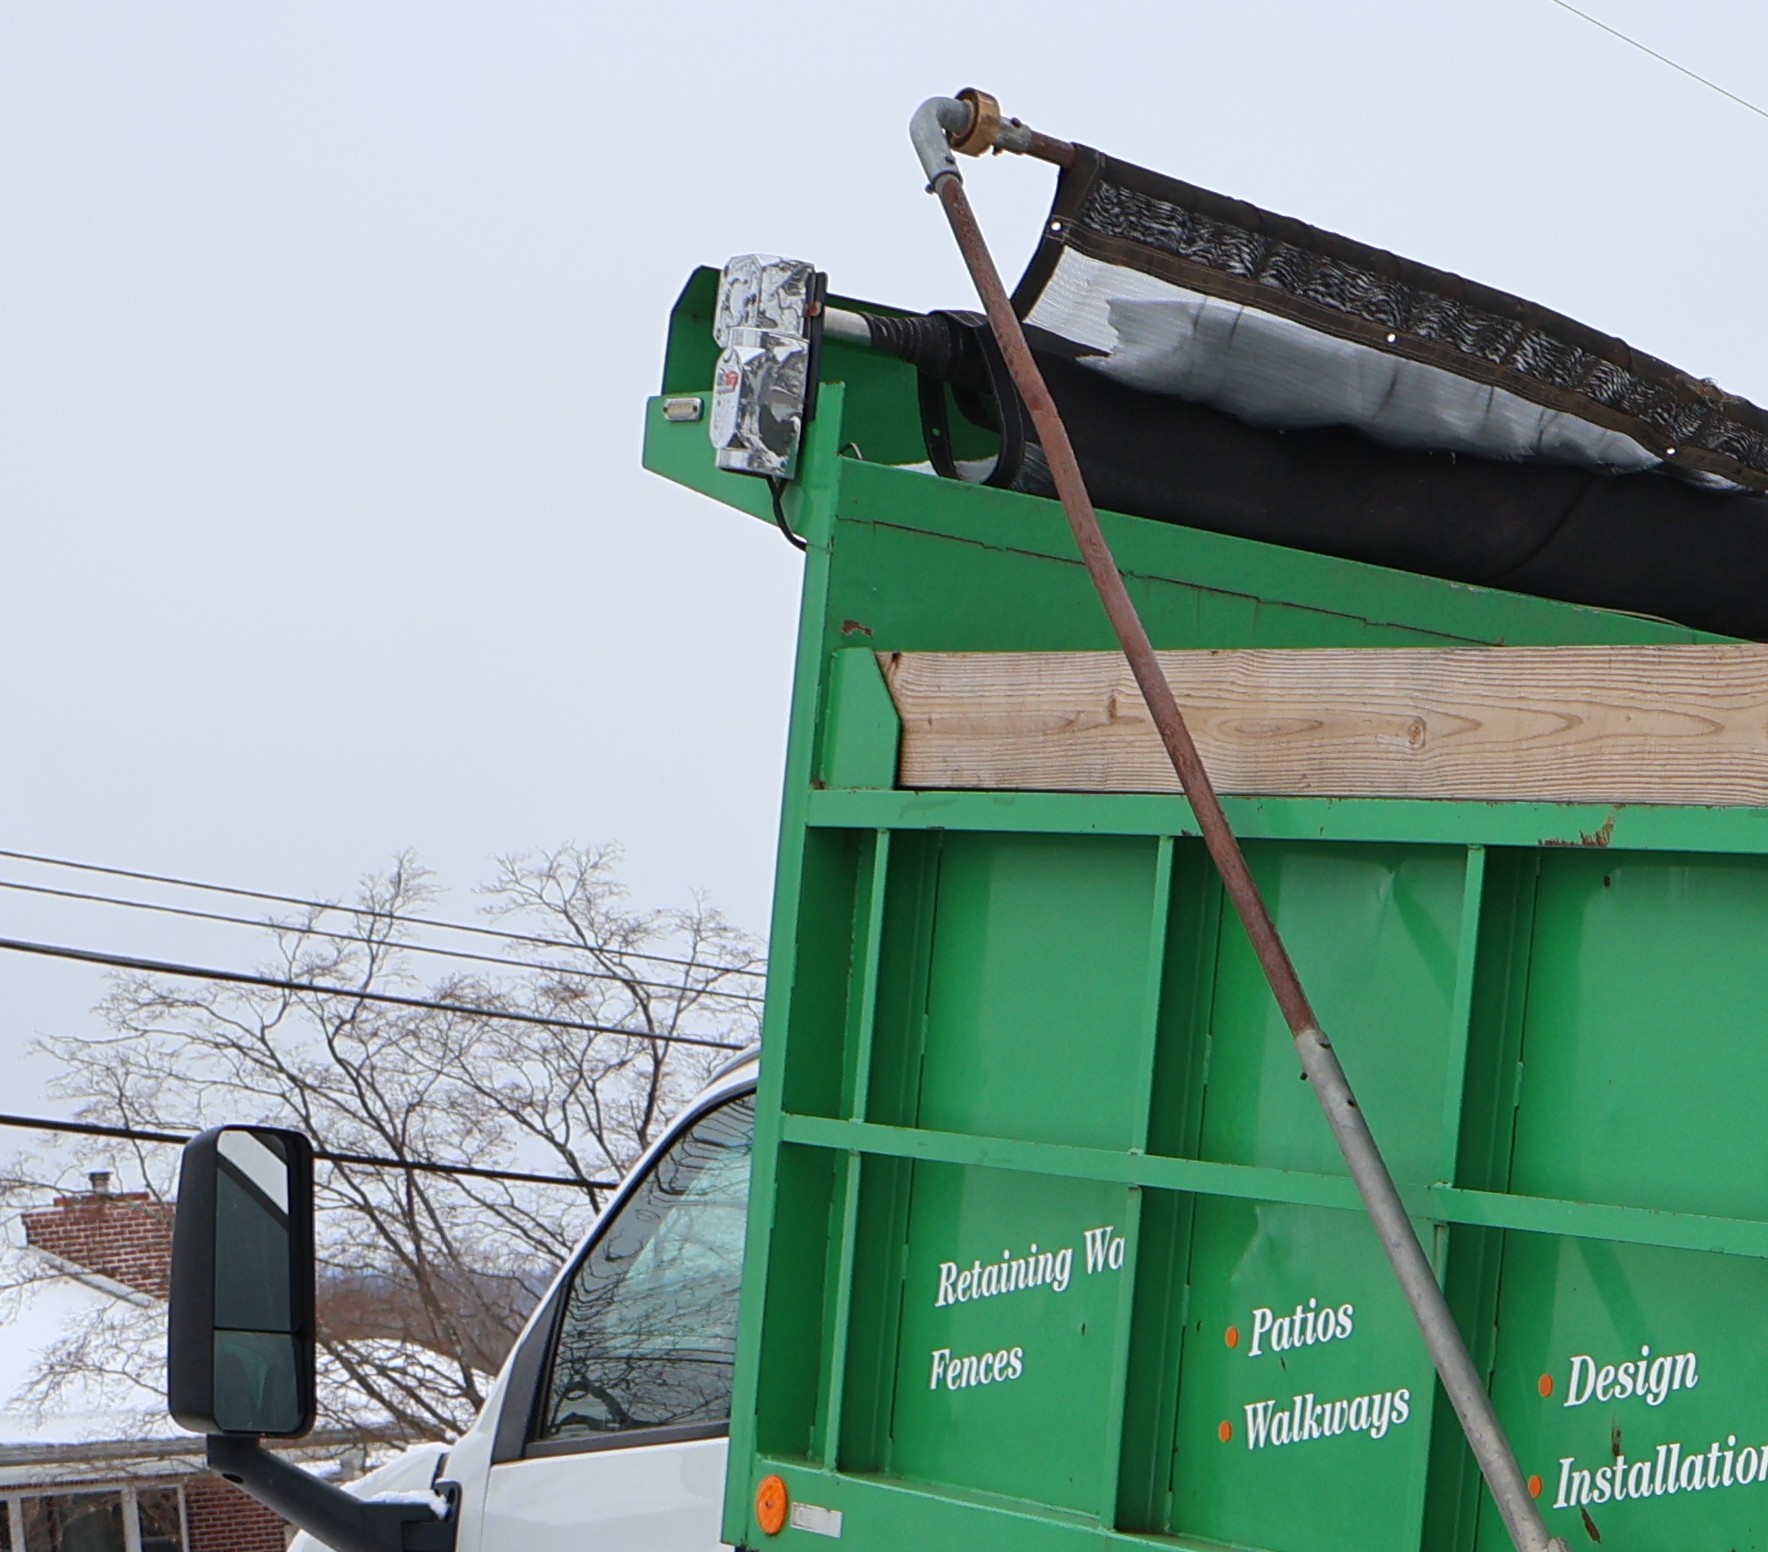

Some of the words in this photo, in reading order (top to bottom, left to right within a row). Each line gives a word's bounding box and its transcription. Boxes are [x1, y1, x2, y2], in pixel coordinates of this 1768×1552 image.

[934, 1243, 1073, 1307] Retaining
[1249, 1297, 1354, 1356] Patios
[929, 1346, 1023, 1390] Fences
[1564, 1345, 1699, 1407] Design
[1244, 1388, 1411, 1450] Walkways
